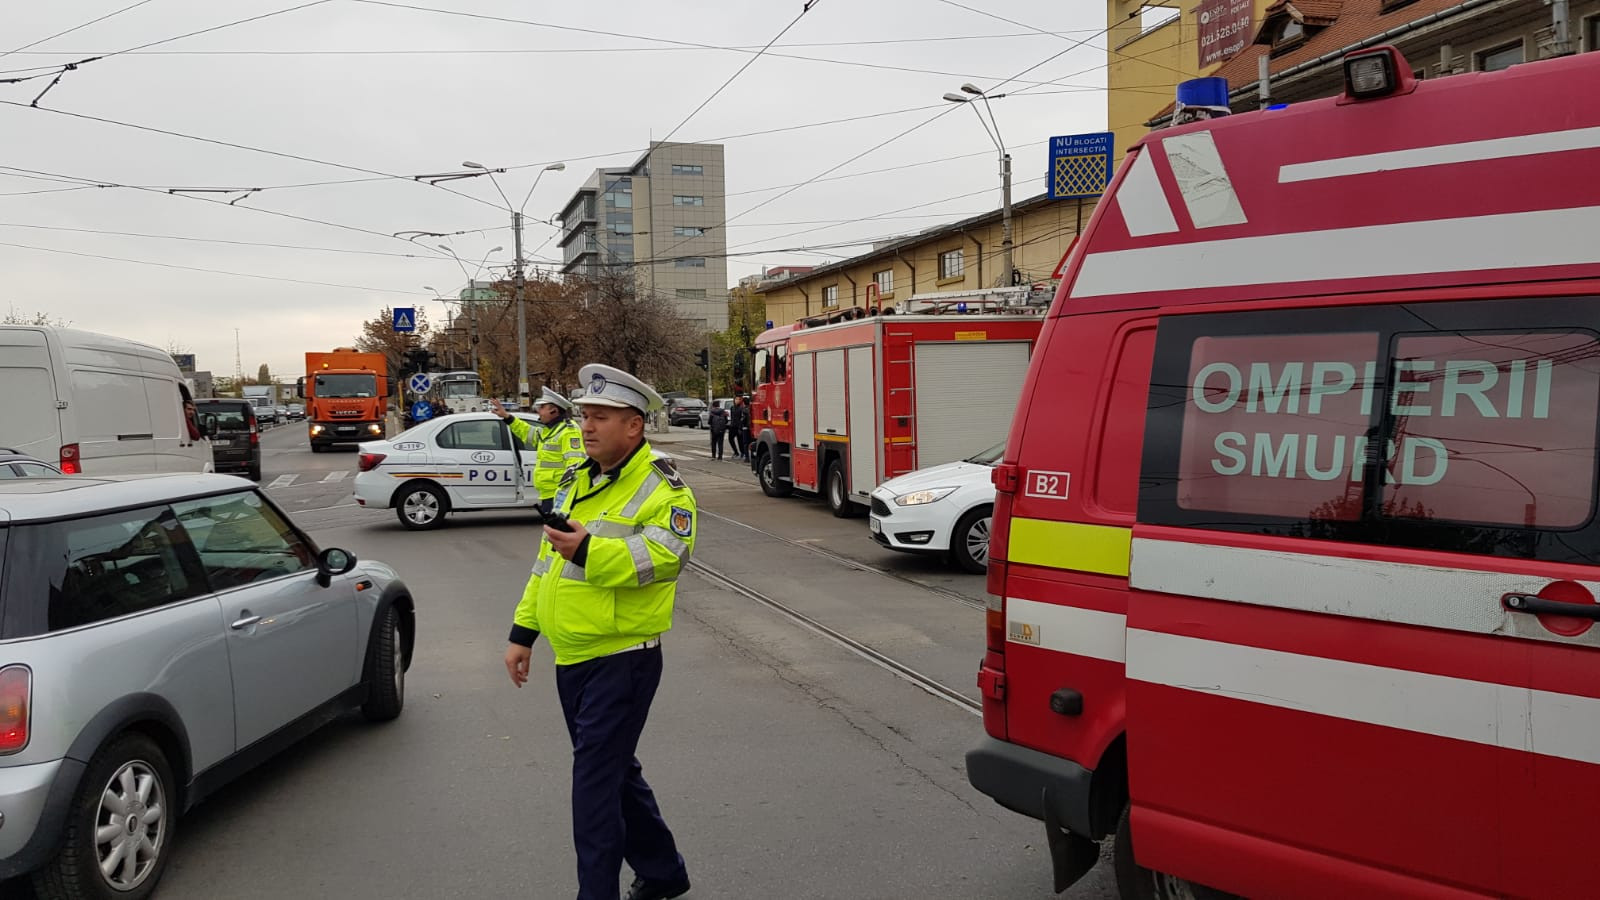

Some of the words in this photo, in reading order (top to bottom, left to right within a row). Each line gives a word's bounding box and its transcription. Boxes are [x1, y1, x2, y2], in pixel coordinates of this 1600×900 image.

[1056, 137, 1072, 147] NU
[1074, 137, 1107, 146] BLOCATI
[1056, 145, 1107, 155] INTERSECTIA
[1192, 359, 1553, 419] OMPIERII
[1036, 475, 1059, 495] B2
